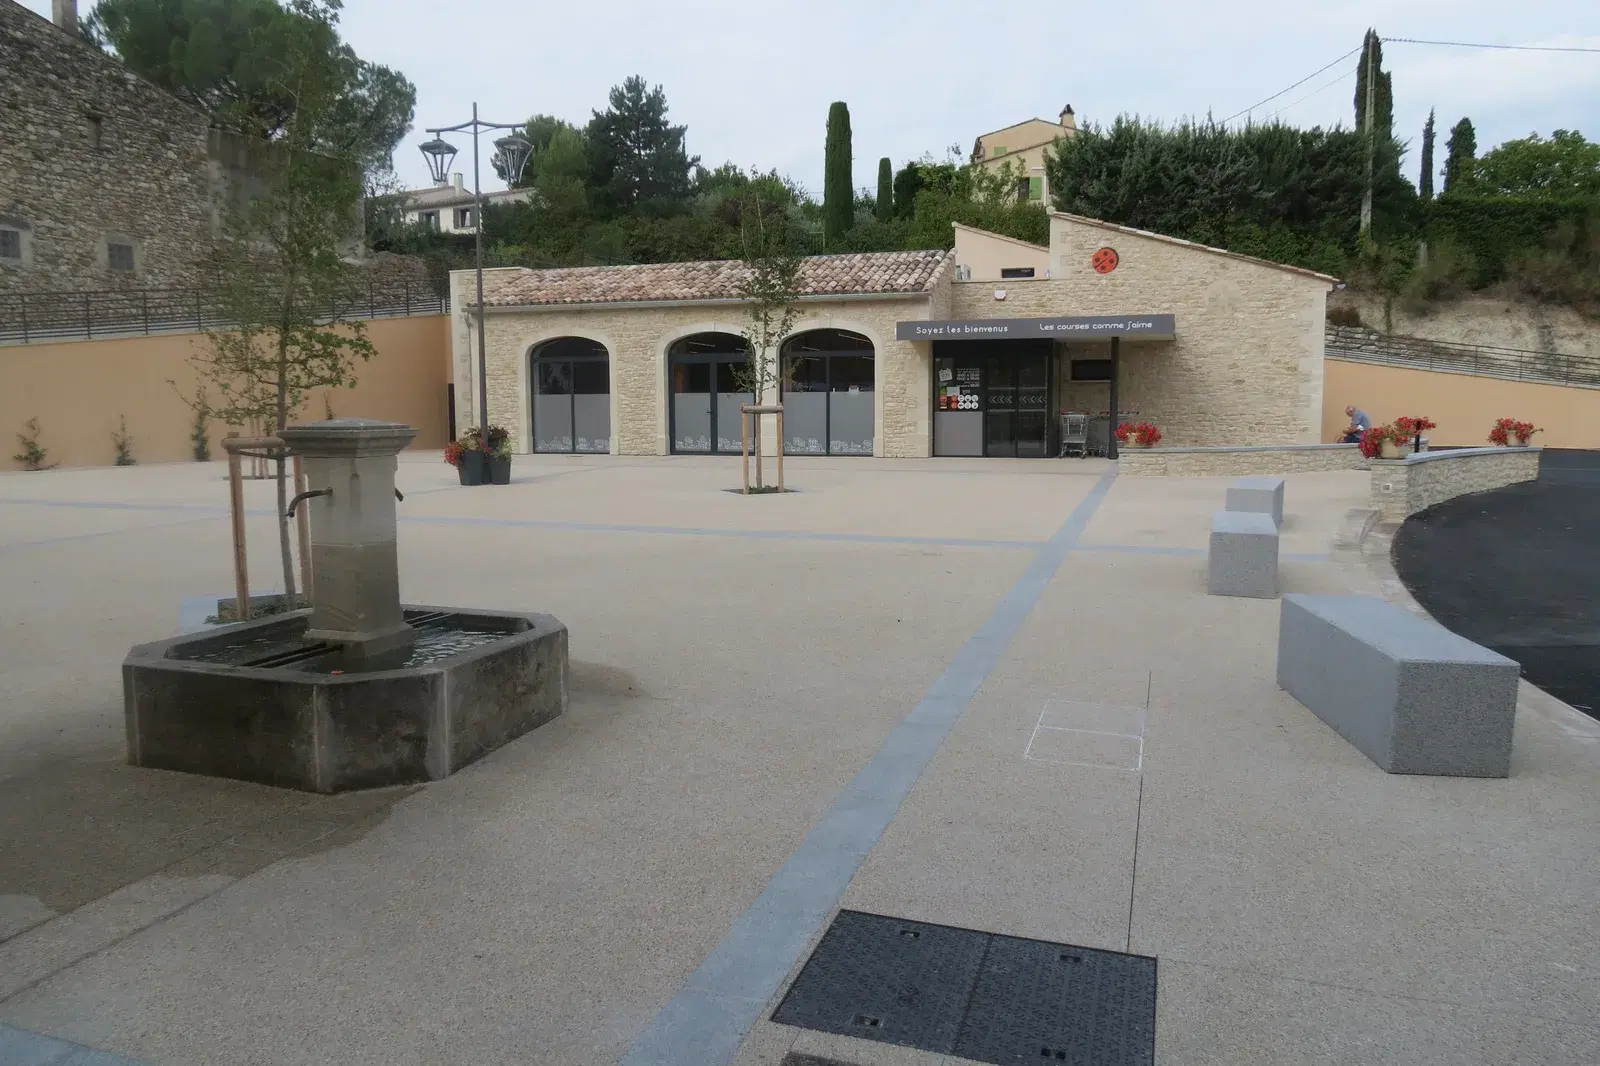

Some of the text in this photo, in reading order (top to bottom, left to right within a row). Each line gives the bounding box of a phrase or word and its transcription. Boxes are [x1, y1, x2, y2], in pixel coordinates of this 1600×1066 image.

[916, 325, 1008, 335] Soyez les bienvenus
[1040, 323, 1054, 331] Les
